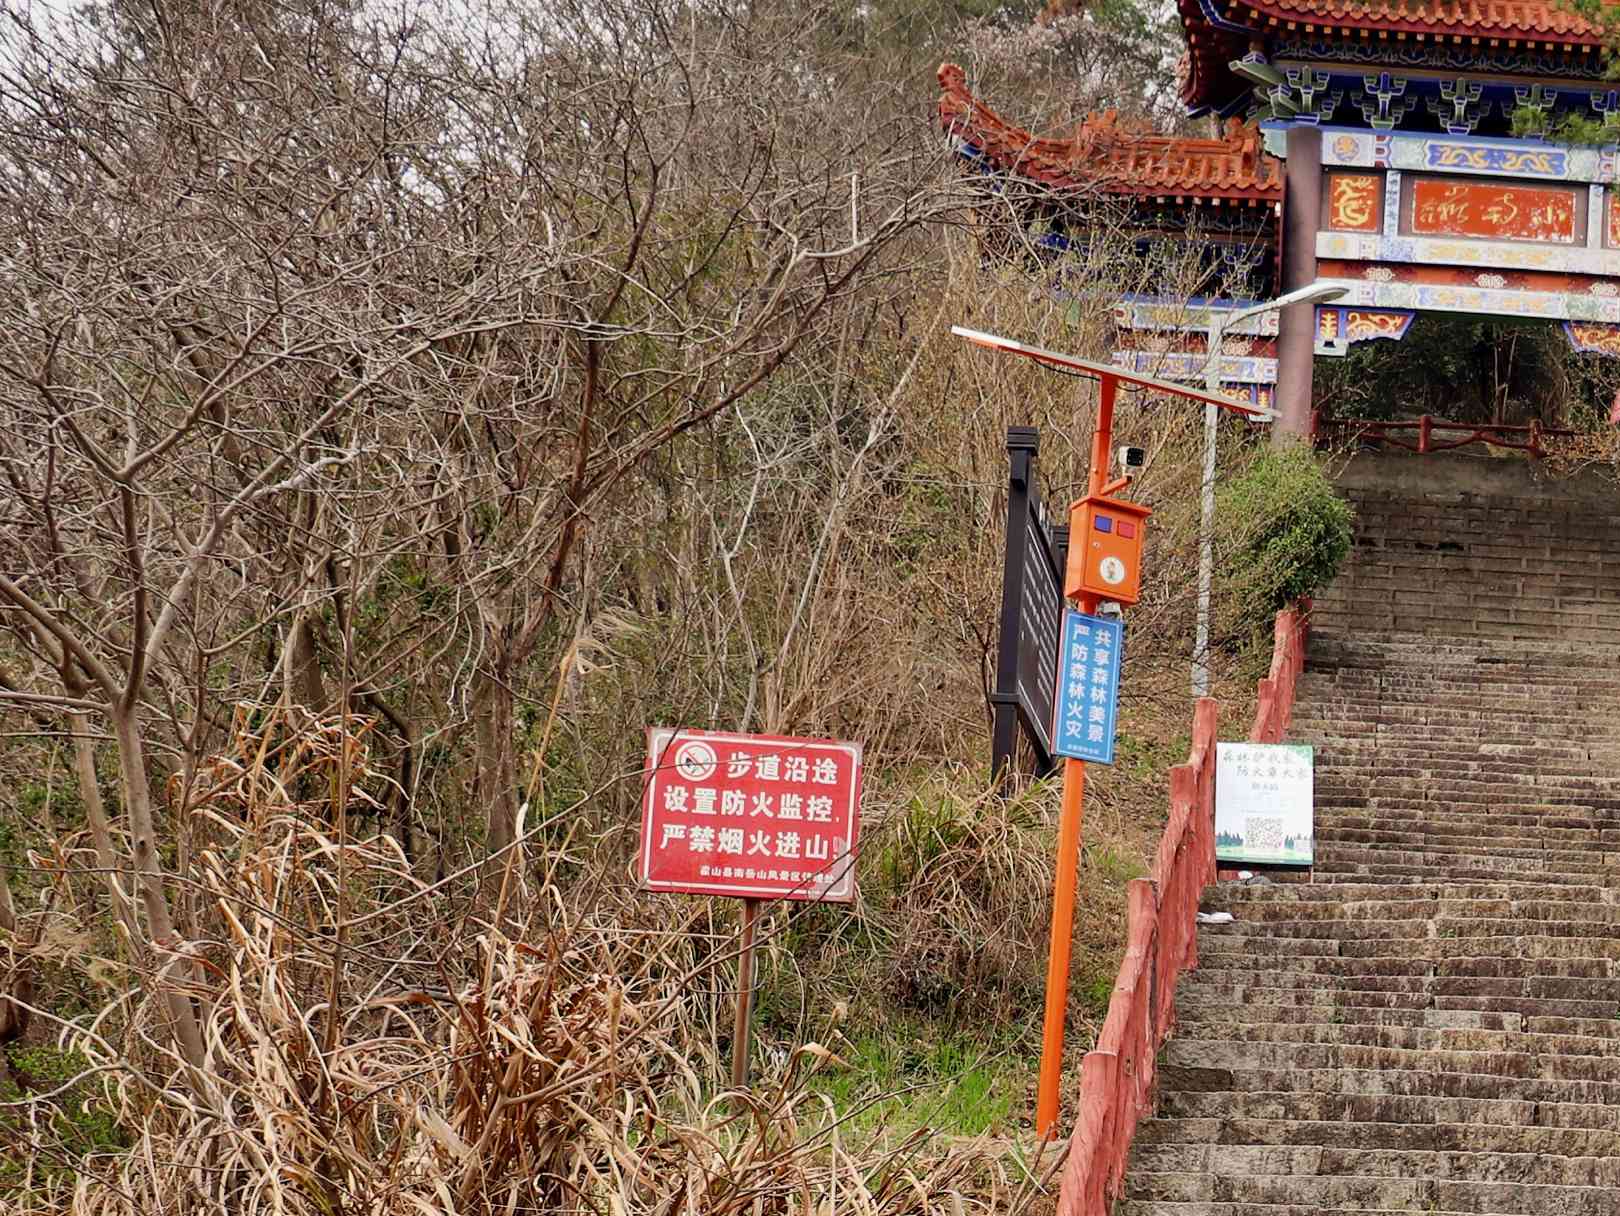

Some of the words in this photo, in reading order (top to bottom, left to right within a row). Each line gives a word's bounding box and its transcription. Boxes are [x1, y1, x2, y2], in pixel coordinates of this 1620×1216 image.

[1064, 624, 1091, 739] 严防森林火灾
[1087, 630, 1113, 743] 共享森林美景
[727, 752, 838, 785] 步道沿途
